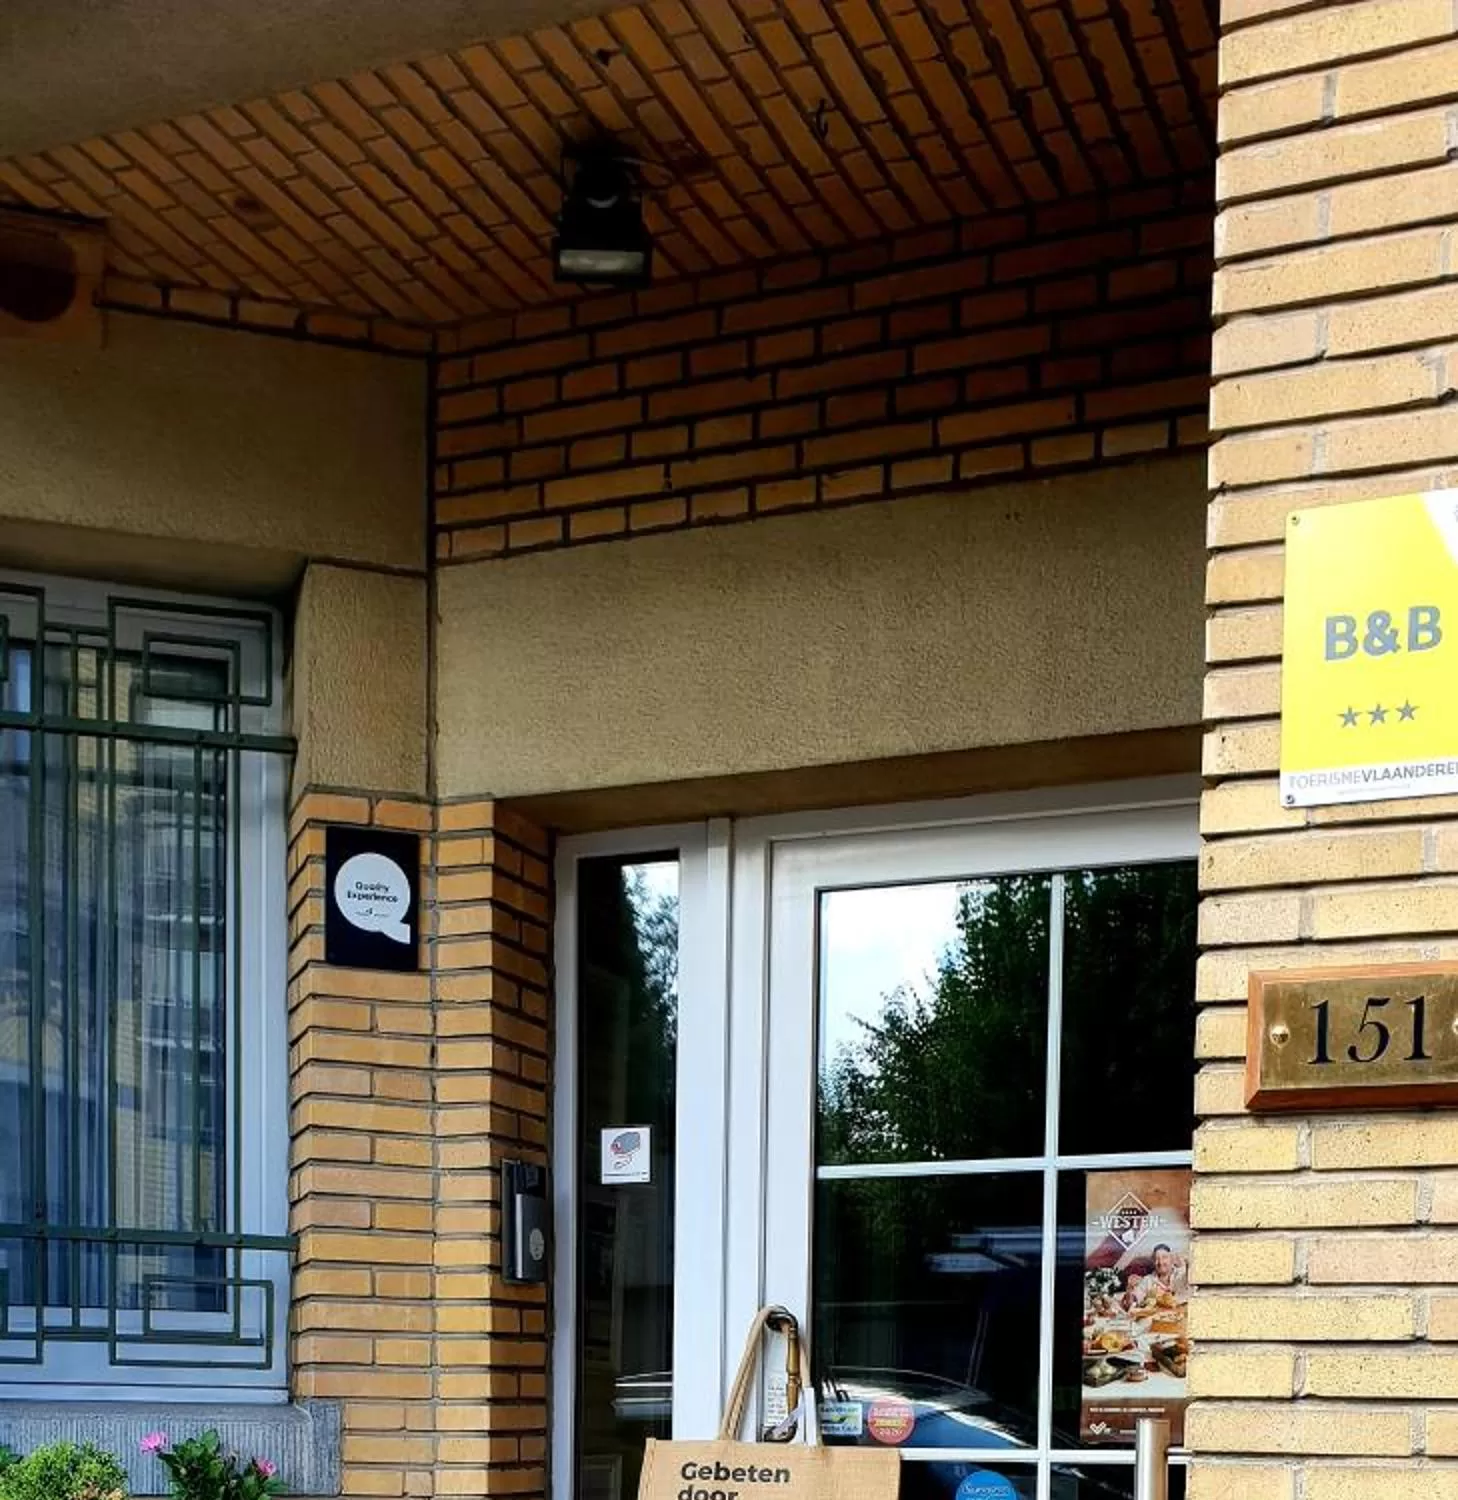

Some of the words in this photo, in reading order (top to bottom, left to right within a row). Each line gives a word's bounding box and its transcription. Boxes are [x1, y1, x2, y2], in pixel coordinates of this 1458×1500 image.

[1324, 605, 1443, 661] B&B
[347, 890, 398, 903] Experience
[1307, 995, 1432, 1064] 151
[680, 1462, 791, 1483] Gebeten
